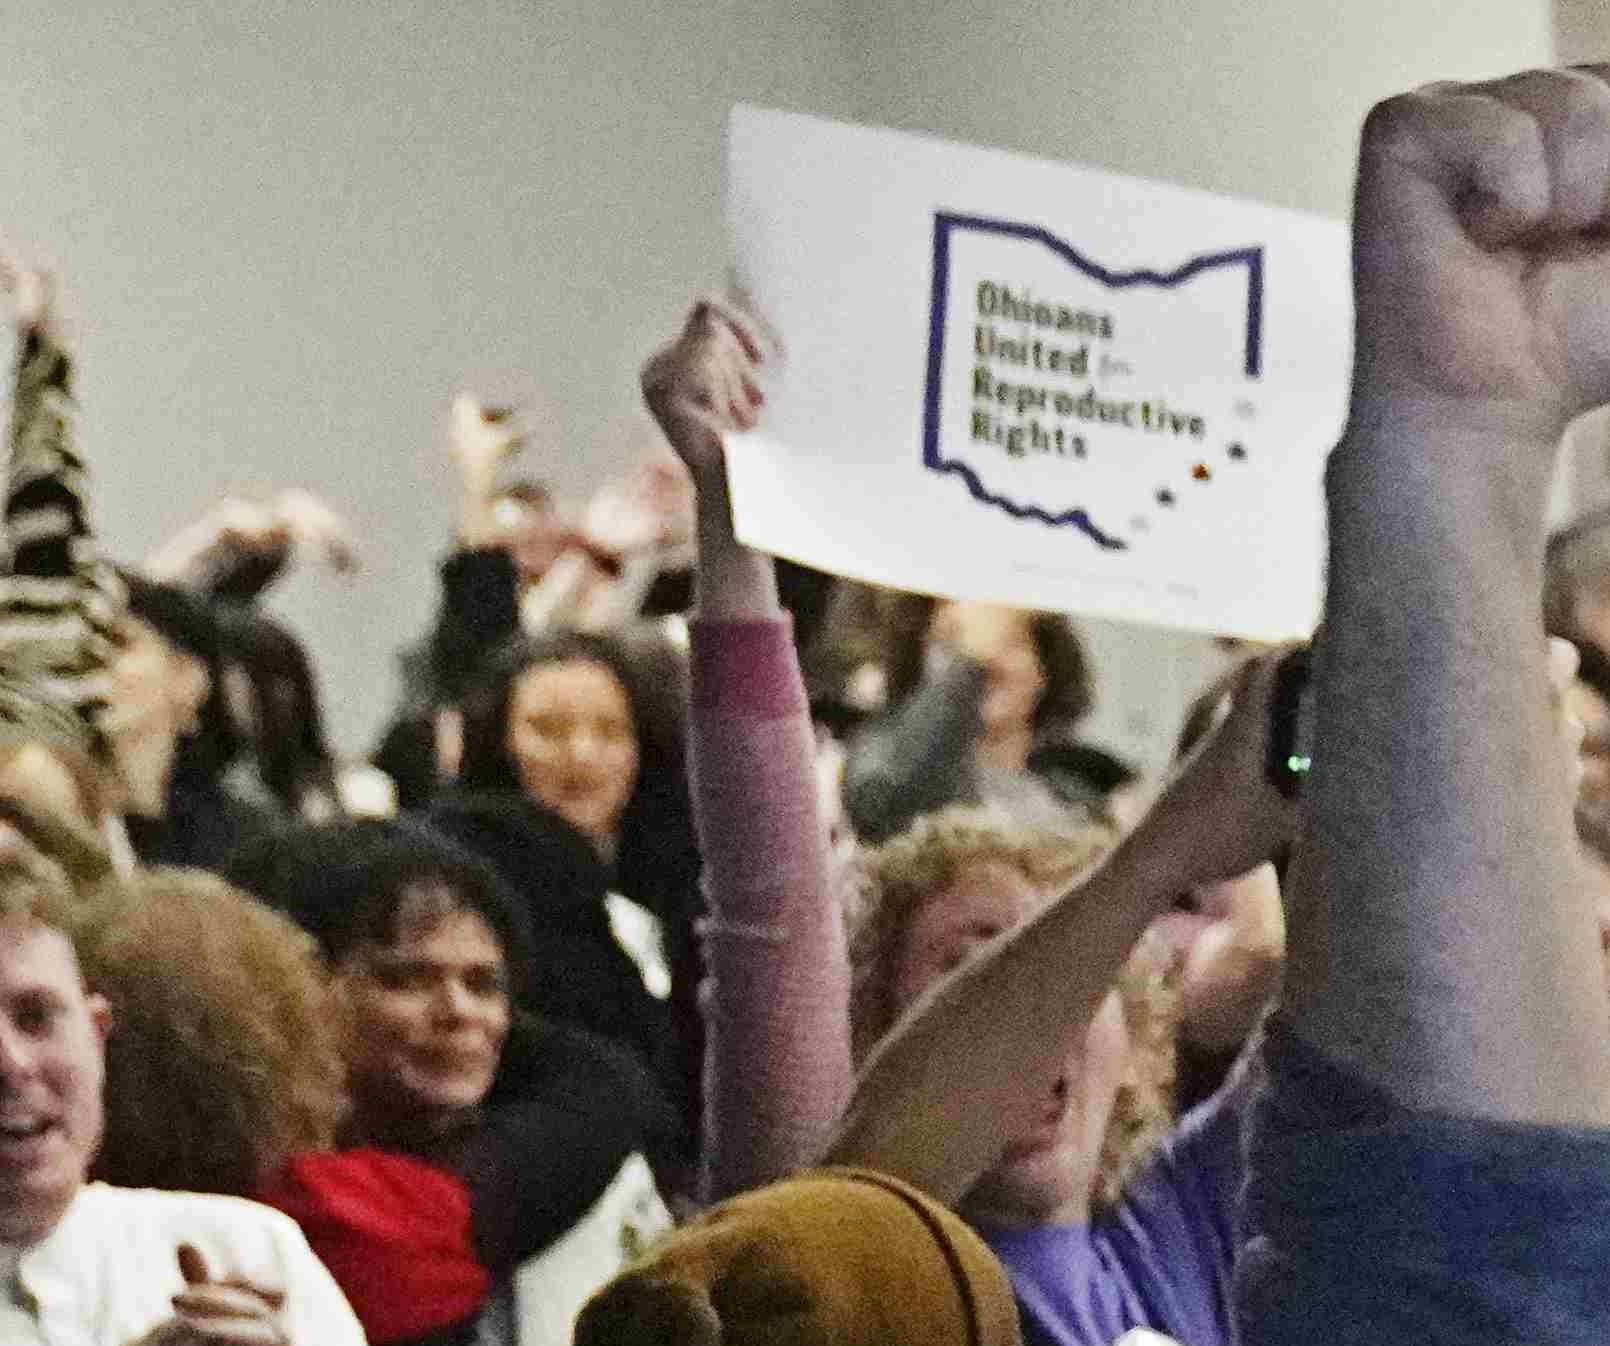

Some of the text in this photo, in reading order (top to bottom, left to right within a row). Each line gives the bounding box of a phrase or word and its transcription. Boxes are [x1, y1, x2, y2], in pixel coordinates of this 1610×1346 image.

[977, 280, 1113, 340] Ohioans
[974, 325, 1089, 378] United
[971, 367, 1205, 438] Reproductive
[970, 409, 1087, 460] Rights
